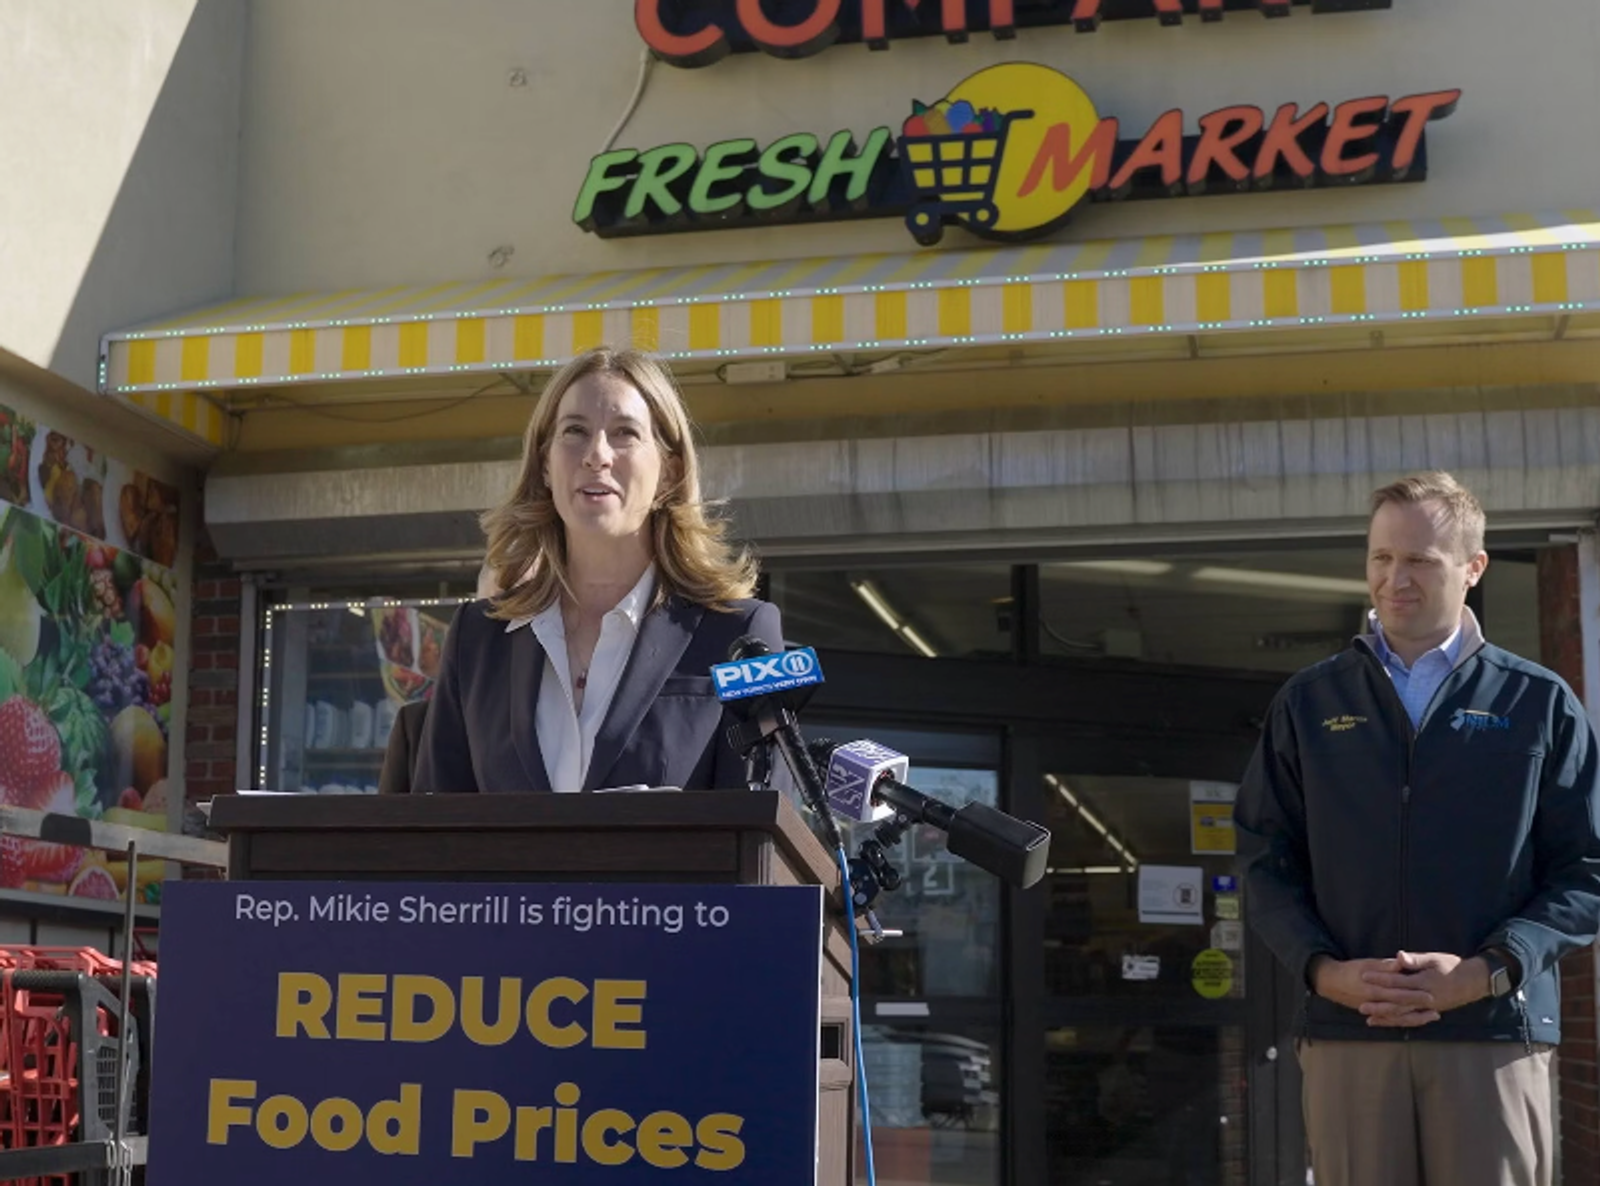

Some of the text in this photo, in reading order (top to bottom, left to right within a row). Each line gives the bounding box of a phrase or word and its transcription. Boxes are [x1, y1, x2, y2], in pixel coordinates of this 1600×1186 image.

[573, 89, 1462, 222] FRESH MARKET
[715, 658, 784, 688] PIX
[235, 894, 730, 933] Rep. Mikie Sherrill is fighting to
[276, 972, 647, 1049] REDUCE
[207, 1079, 746, 1171] Food Prices
